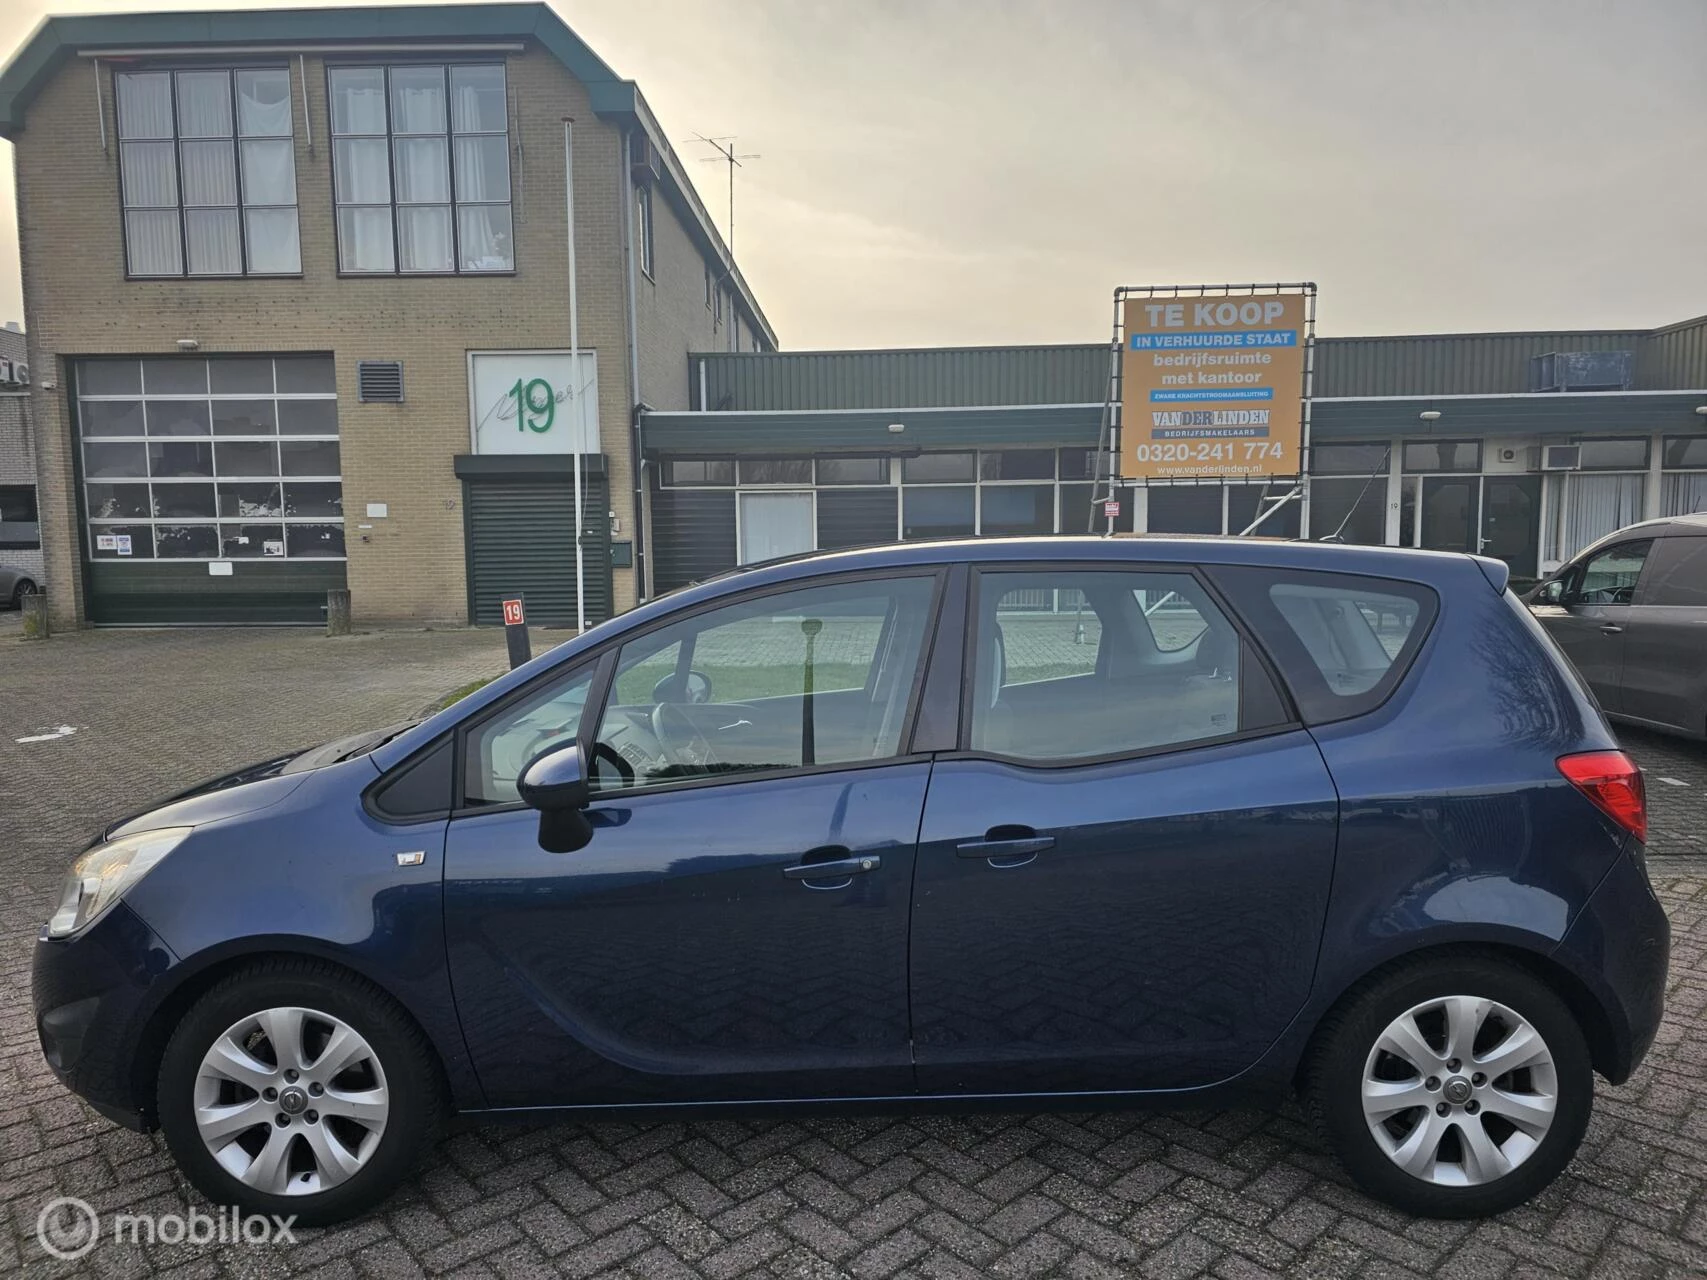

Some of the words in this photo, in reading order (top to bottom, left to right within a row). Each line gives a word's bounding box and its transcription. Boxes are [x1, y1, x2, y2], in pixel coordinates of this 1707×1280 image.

[1144, 303, 1185, 328] TE
[1194, 301, 1285, 326] KOOP
[1136, 335, 1152, 348] IN
[1154, 333, 1243, 347] VERHUURDE
[1246, 332, 1291, 345] STAAT
[1153, 351, 1272, 368] bedrijfsruimte
[1161, 372, 1194, 385] met
[1198, 370, 1262, 384] kantoor
[509, 377, 555, 434] 19
[1164, 428, 1255, 438] BEDRIJFSMAKELAARS
[1136, 442, 1234, 462] 0320-241
[1244, 441, 1284, 460] 774
[1157, 463, 1262, 475] www.vanderlinden.nl
[506, 604, 521, 621] 19
